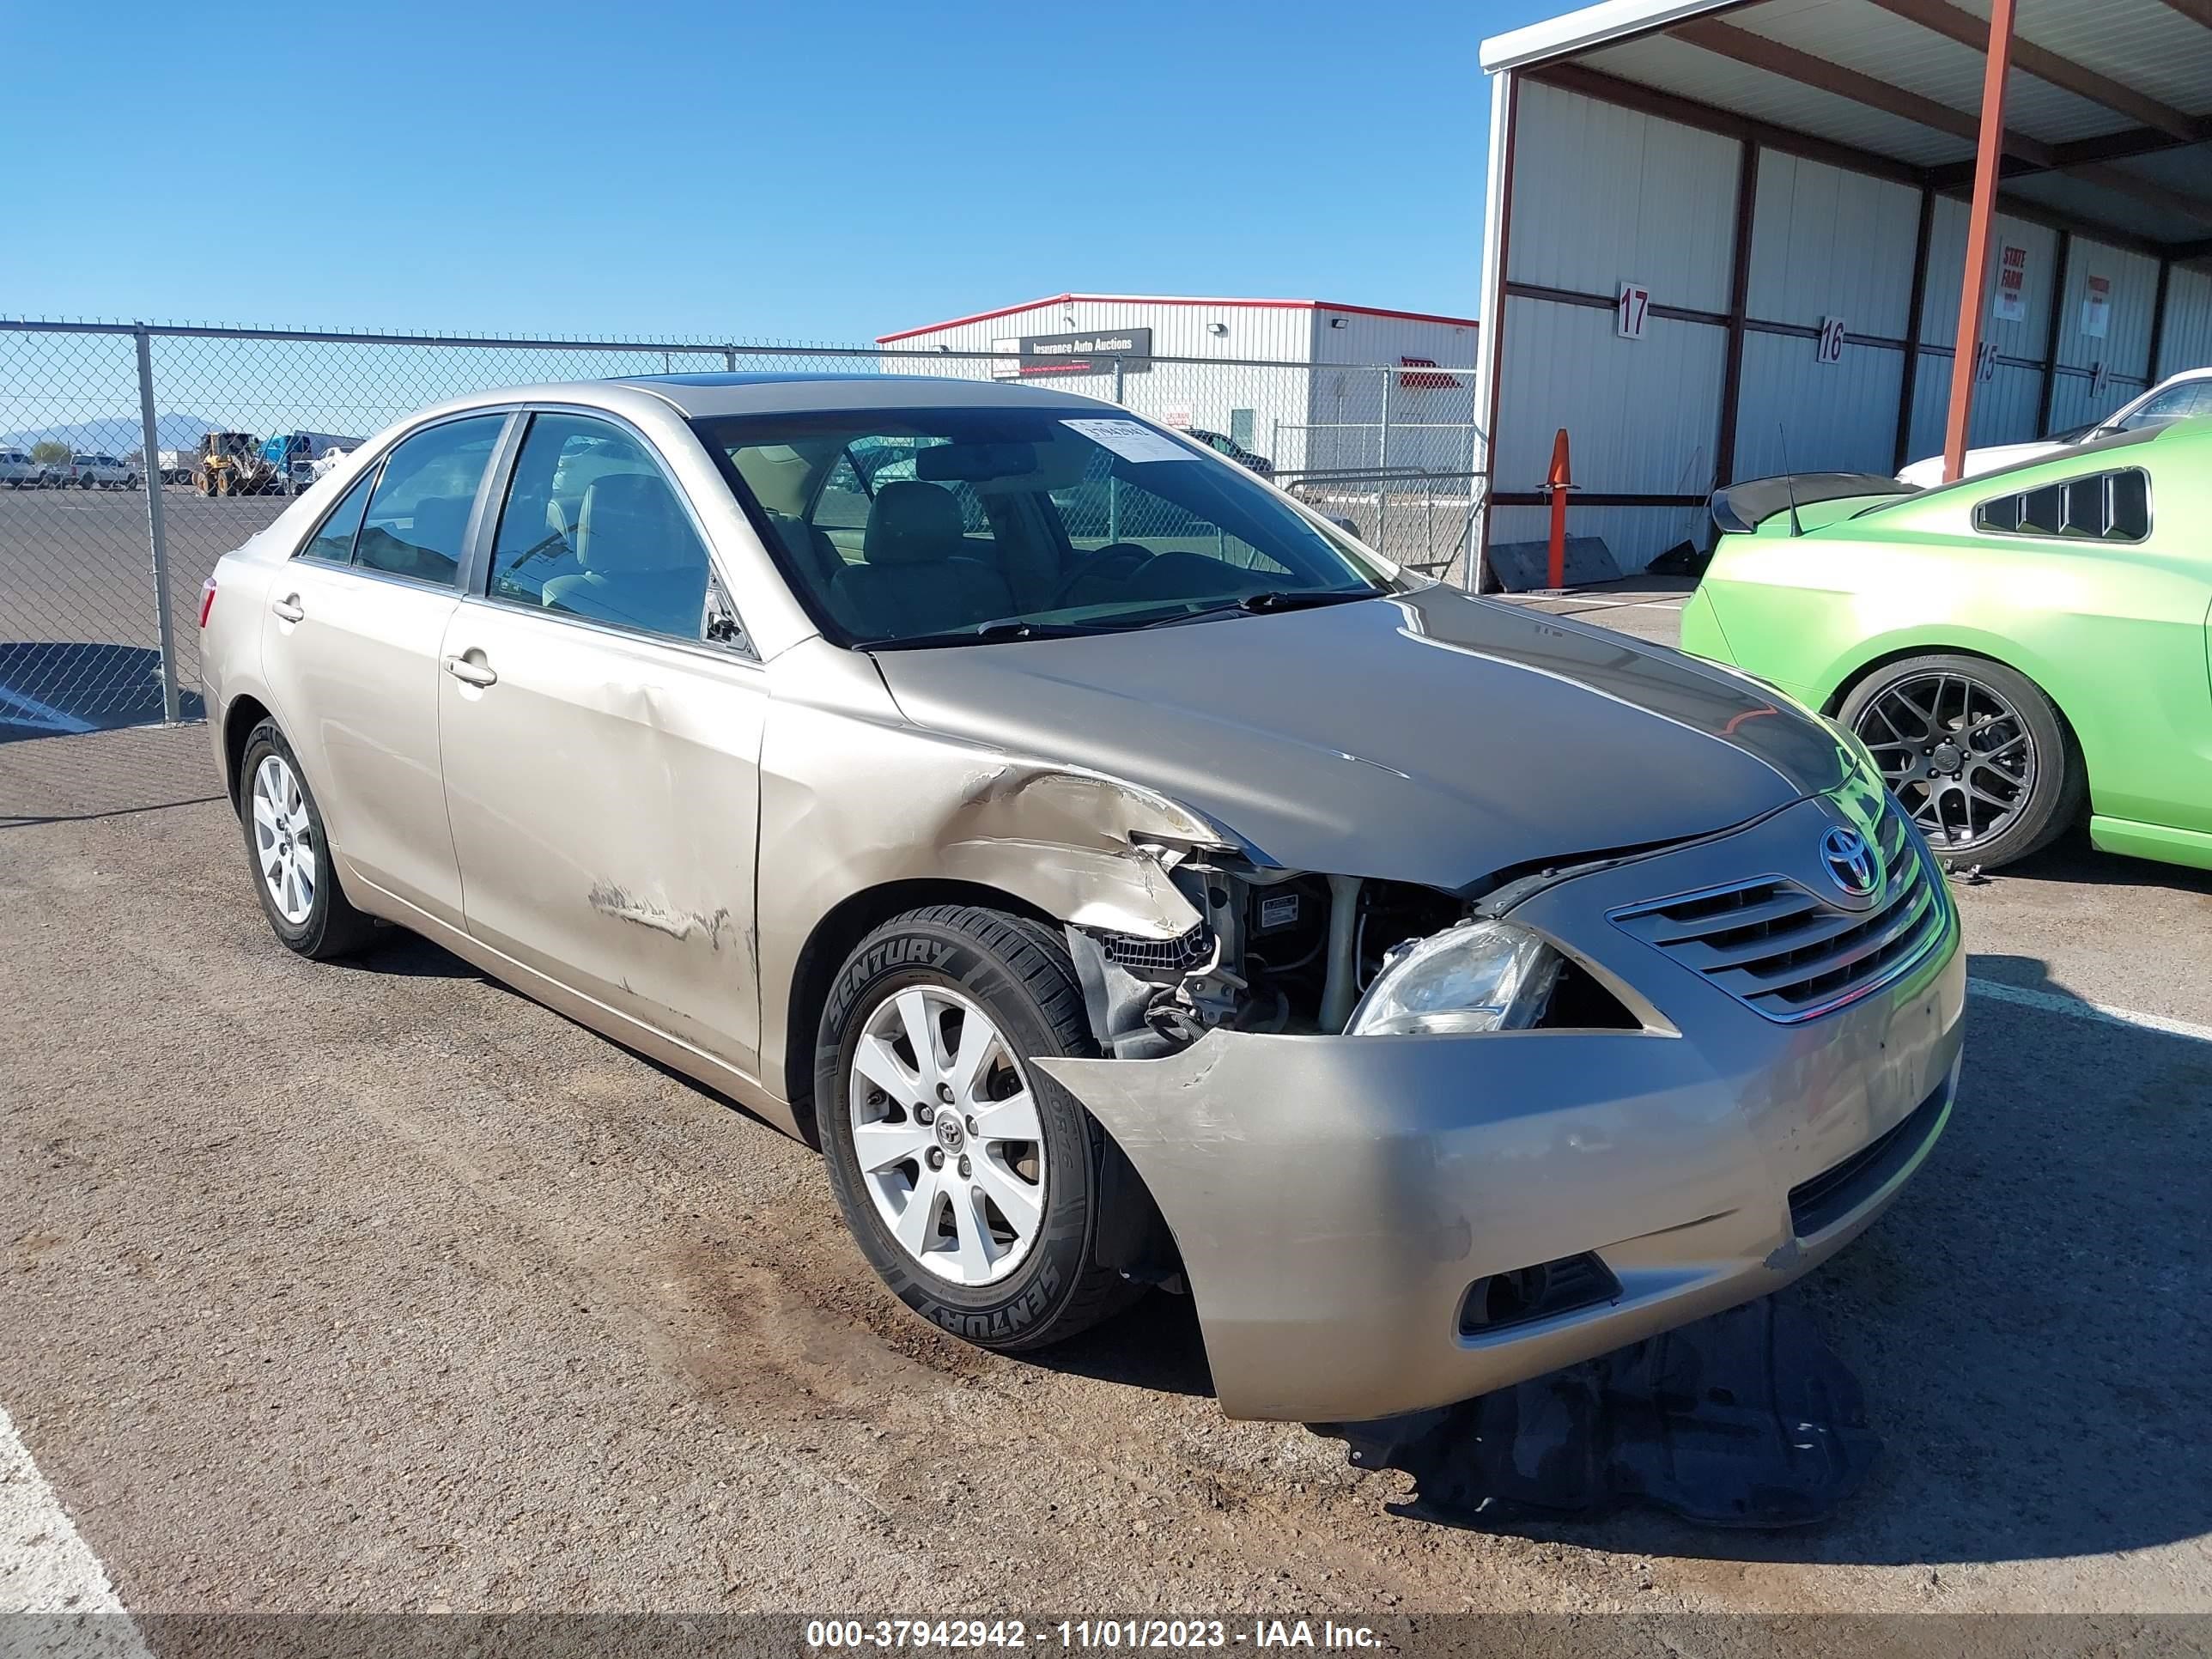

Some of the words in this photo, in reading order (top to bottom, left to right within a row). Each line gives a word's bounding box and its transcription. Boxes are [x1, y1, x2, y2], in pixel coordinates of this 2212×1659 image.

[2003, 246, 2027, 268] STATE
[2001, 268, 2023, 289] FARM
[1620, 288, 1648, 335] 17
[1033, 343, 1073, 355] Insurance
[1073, 339, 1094, 353] Auto
[1094, 337, 1133, 351] Auctions
[1821, 320, 1844, 362] 16
[1979, 345, 1998, 381] 15
[829, 938, 958, 1031] SENTURY
[918, 1256, 1061, 1338] SENTURY
